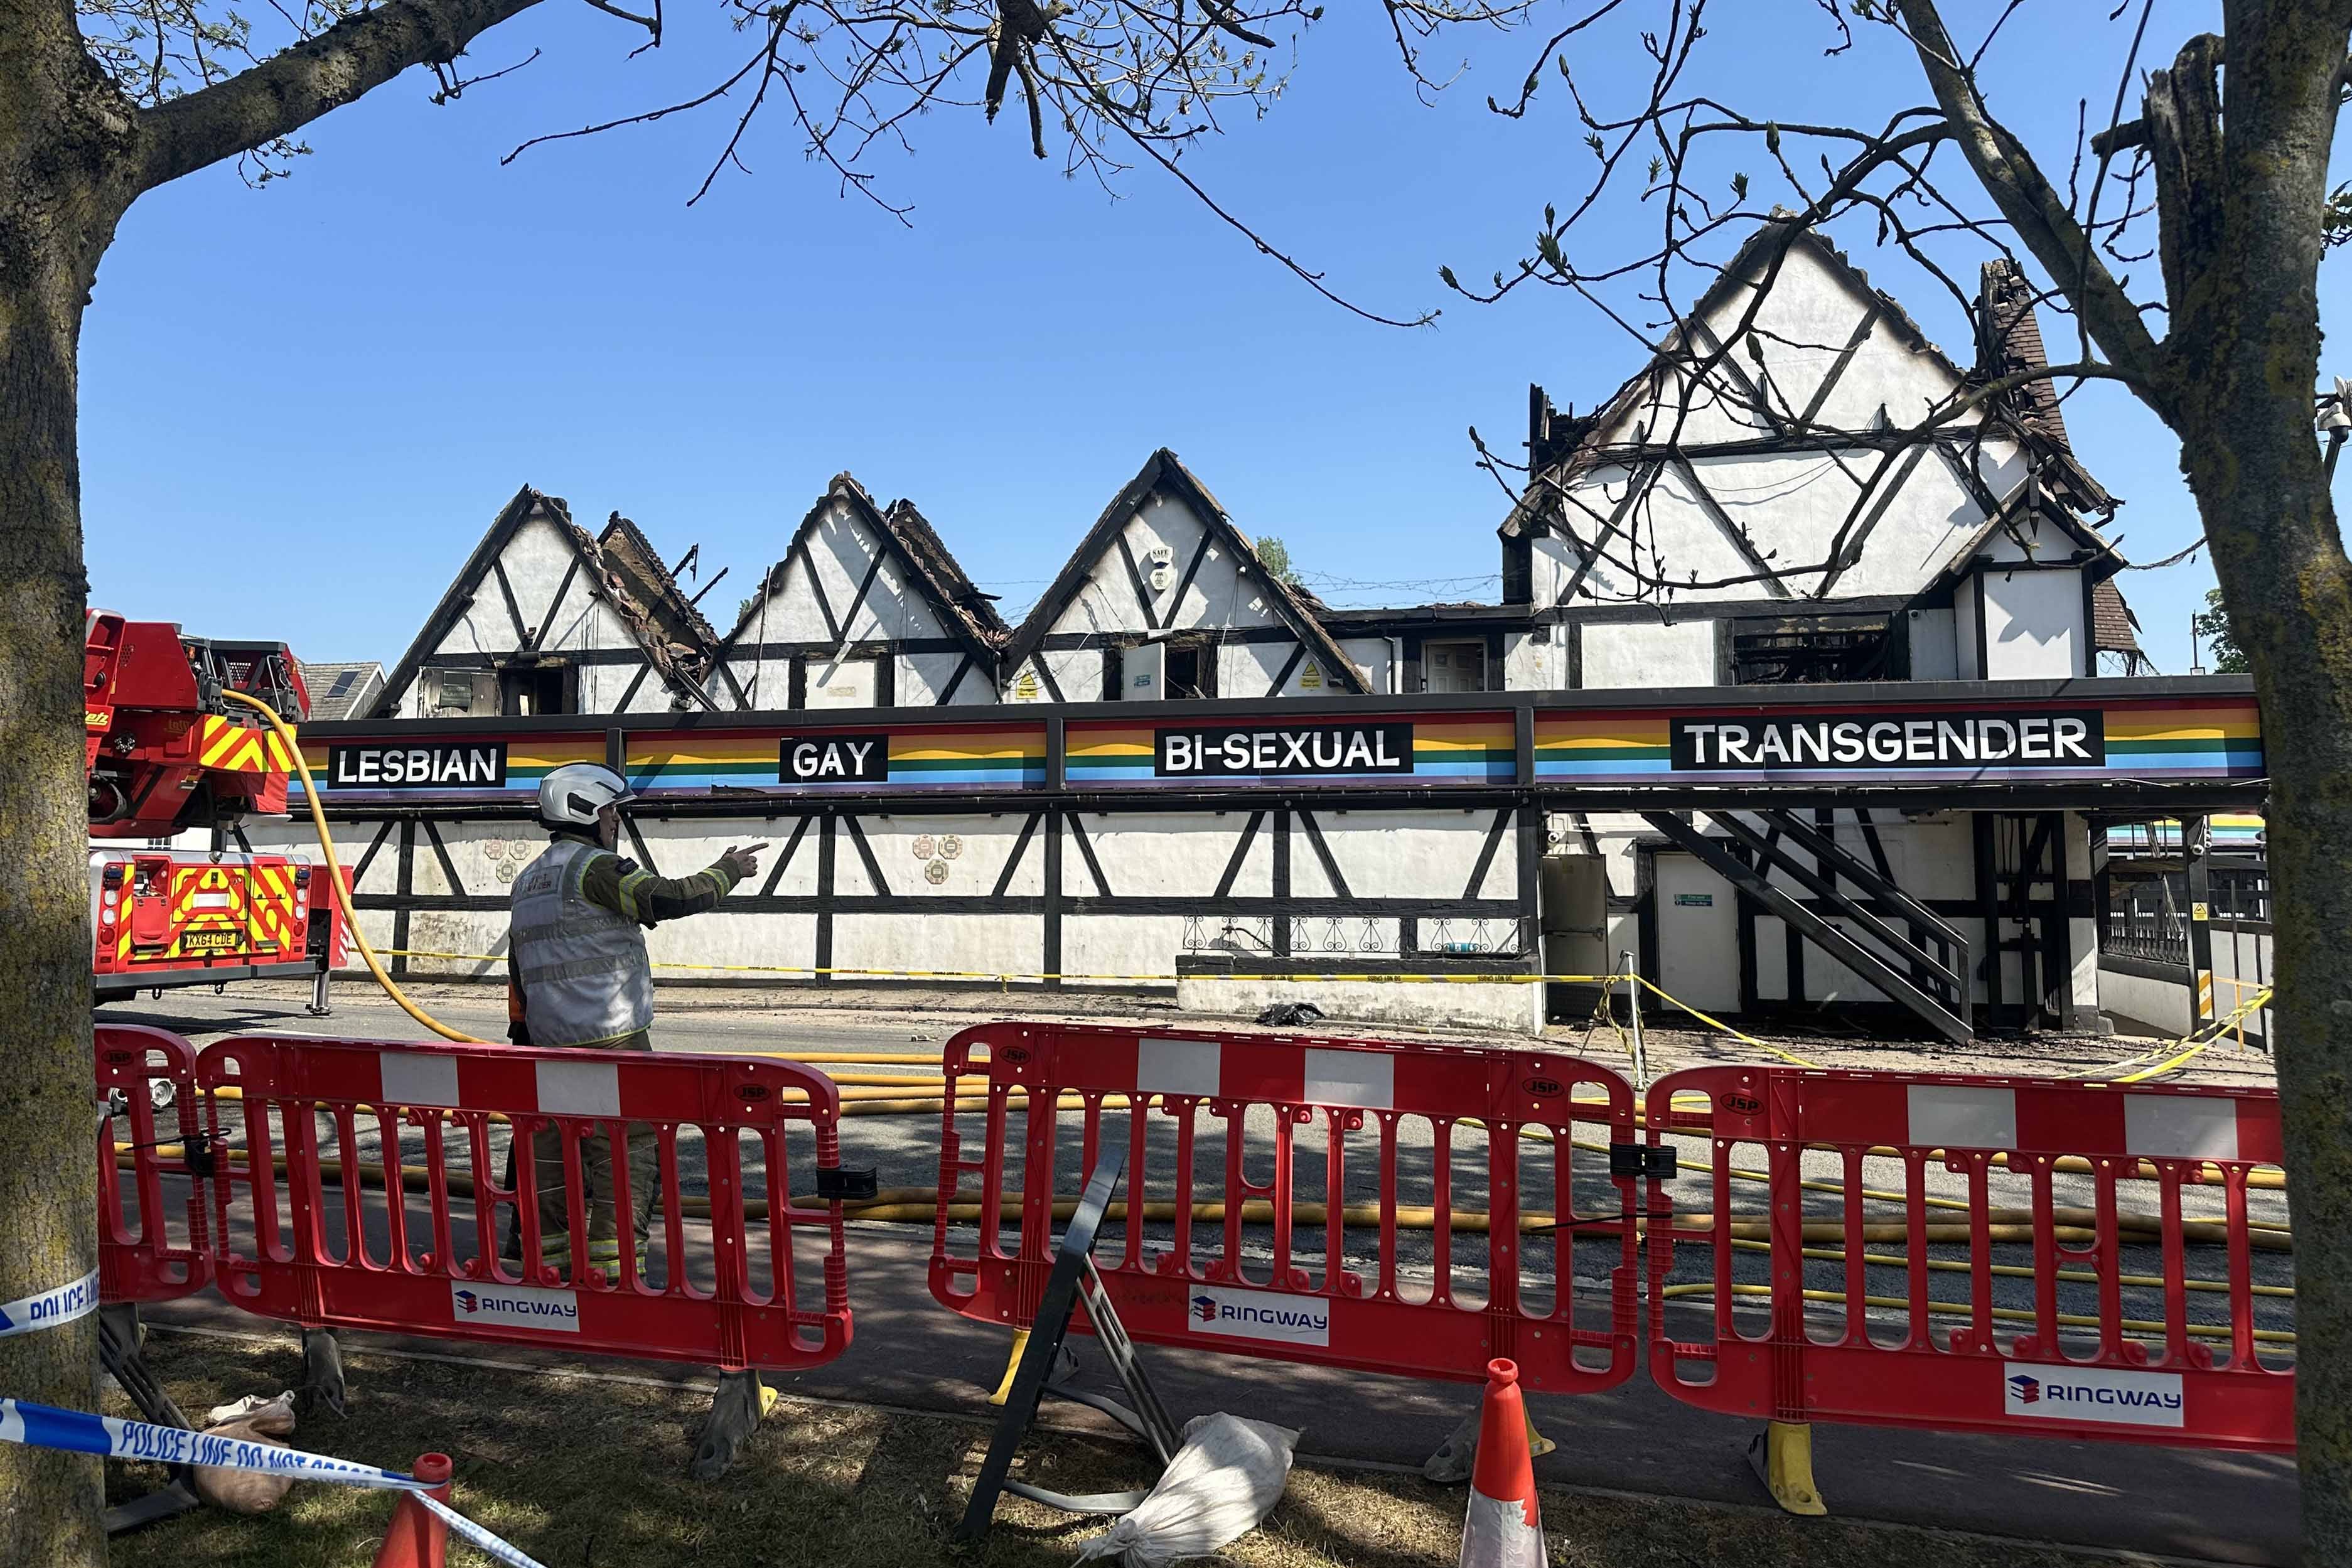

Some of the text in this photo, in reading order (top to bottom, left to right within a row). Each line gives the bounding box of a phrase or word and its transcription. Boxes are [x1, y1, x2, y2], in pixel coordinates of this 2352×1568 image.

[1164, 730, 1400, 771] BI-SEXUAL
[1683, 717, 2092, 764] TRANSGENDER
[338, 748, 497, 783] LESBIAN
[792, 741, 874, 777] GAY
[189, 933, 232, 946] KX64 CDE
[1529, 1080, 1559, 1093] JSP
[1727, 1097, 1759, 1111] JSP
[481, 1297, 577, 1317] RINGWAY
[1222, 1305, 1328, 1329] RINGWAY
[2046, 1384, 2181, 1409] RINGWAY
[119, 1420, 188, 1461] POLICE
[186, 1434, 234, 1466] LINE
